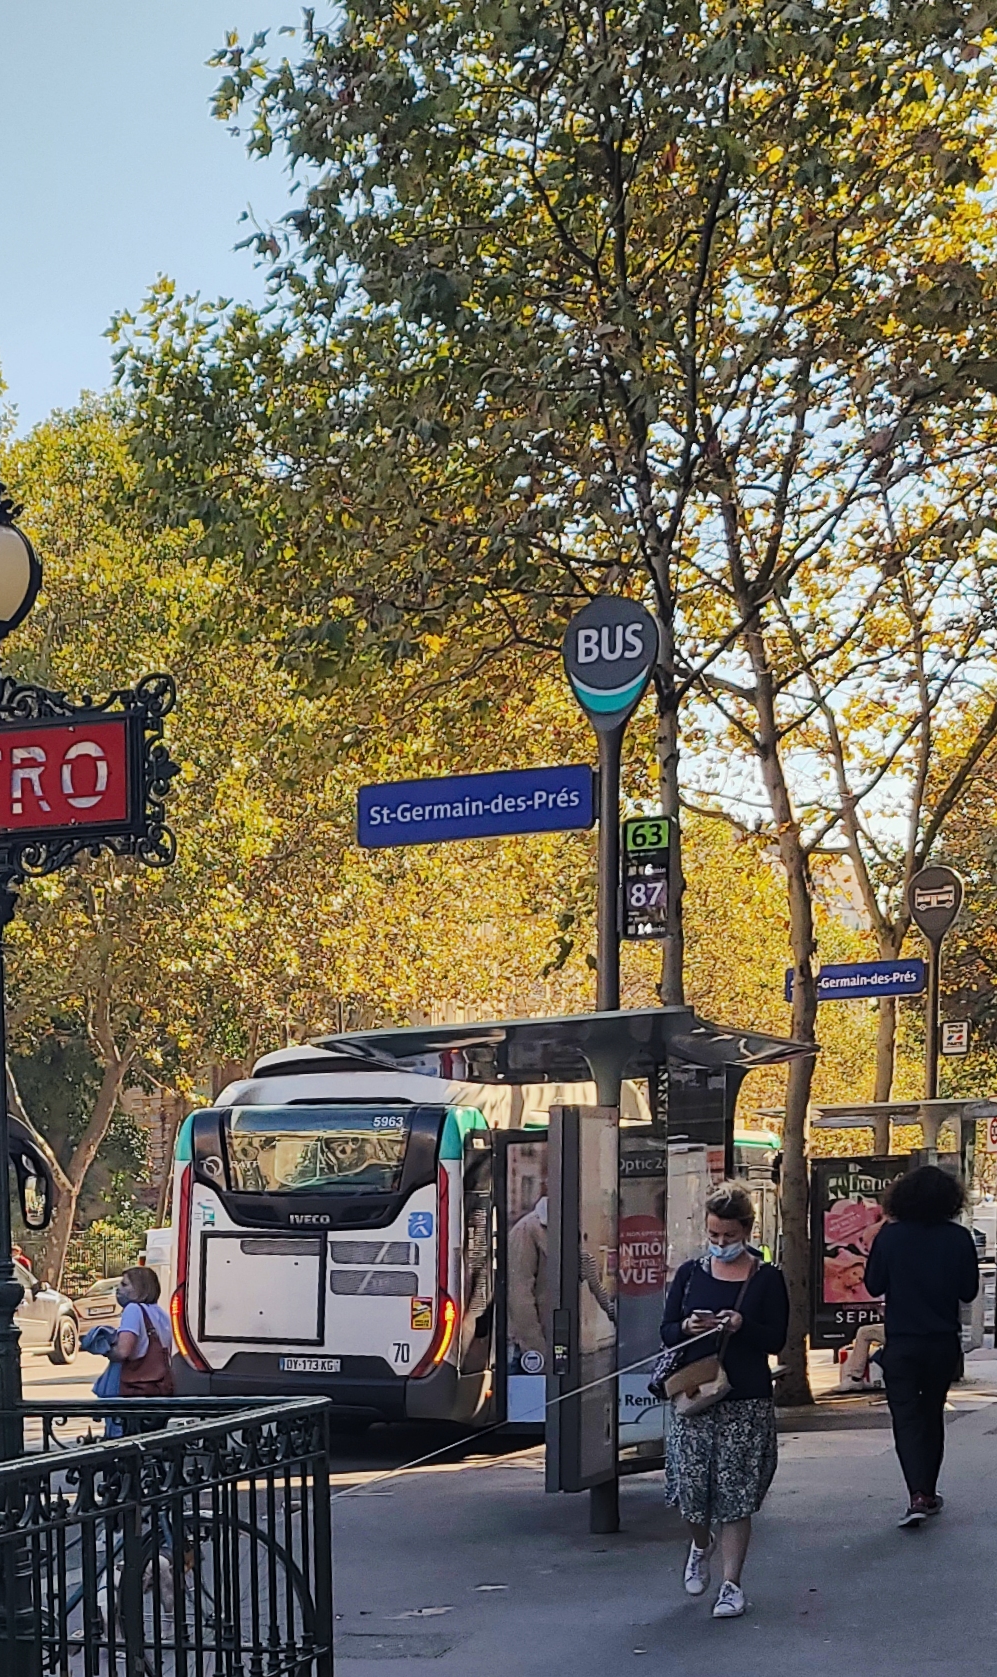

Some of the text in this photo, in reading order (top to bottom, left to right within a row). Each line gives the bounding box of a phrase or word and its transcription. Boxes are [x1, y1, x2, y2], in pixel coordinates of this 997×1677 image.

[576, 622, 644, 664] BUS
[369, 788, 580, 825] St-Germain-des-Prés
[631, 824, 662, 847] 63
[630, 882, 663, 907] 87
[791, 970, 917, 989] -Germain-des-Prés
[373, 1117, 404, 1127] 5963
[289, 1214, 330, 1224] IVECO
[619, 1268, 658, 1284] VUE
[835, 1310, 880, 1323] SEPH
[393, 1343, 410, 1363] 70
[625, 1395, 660, 1406] Renn
